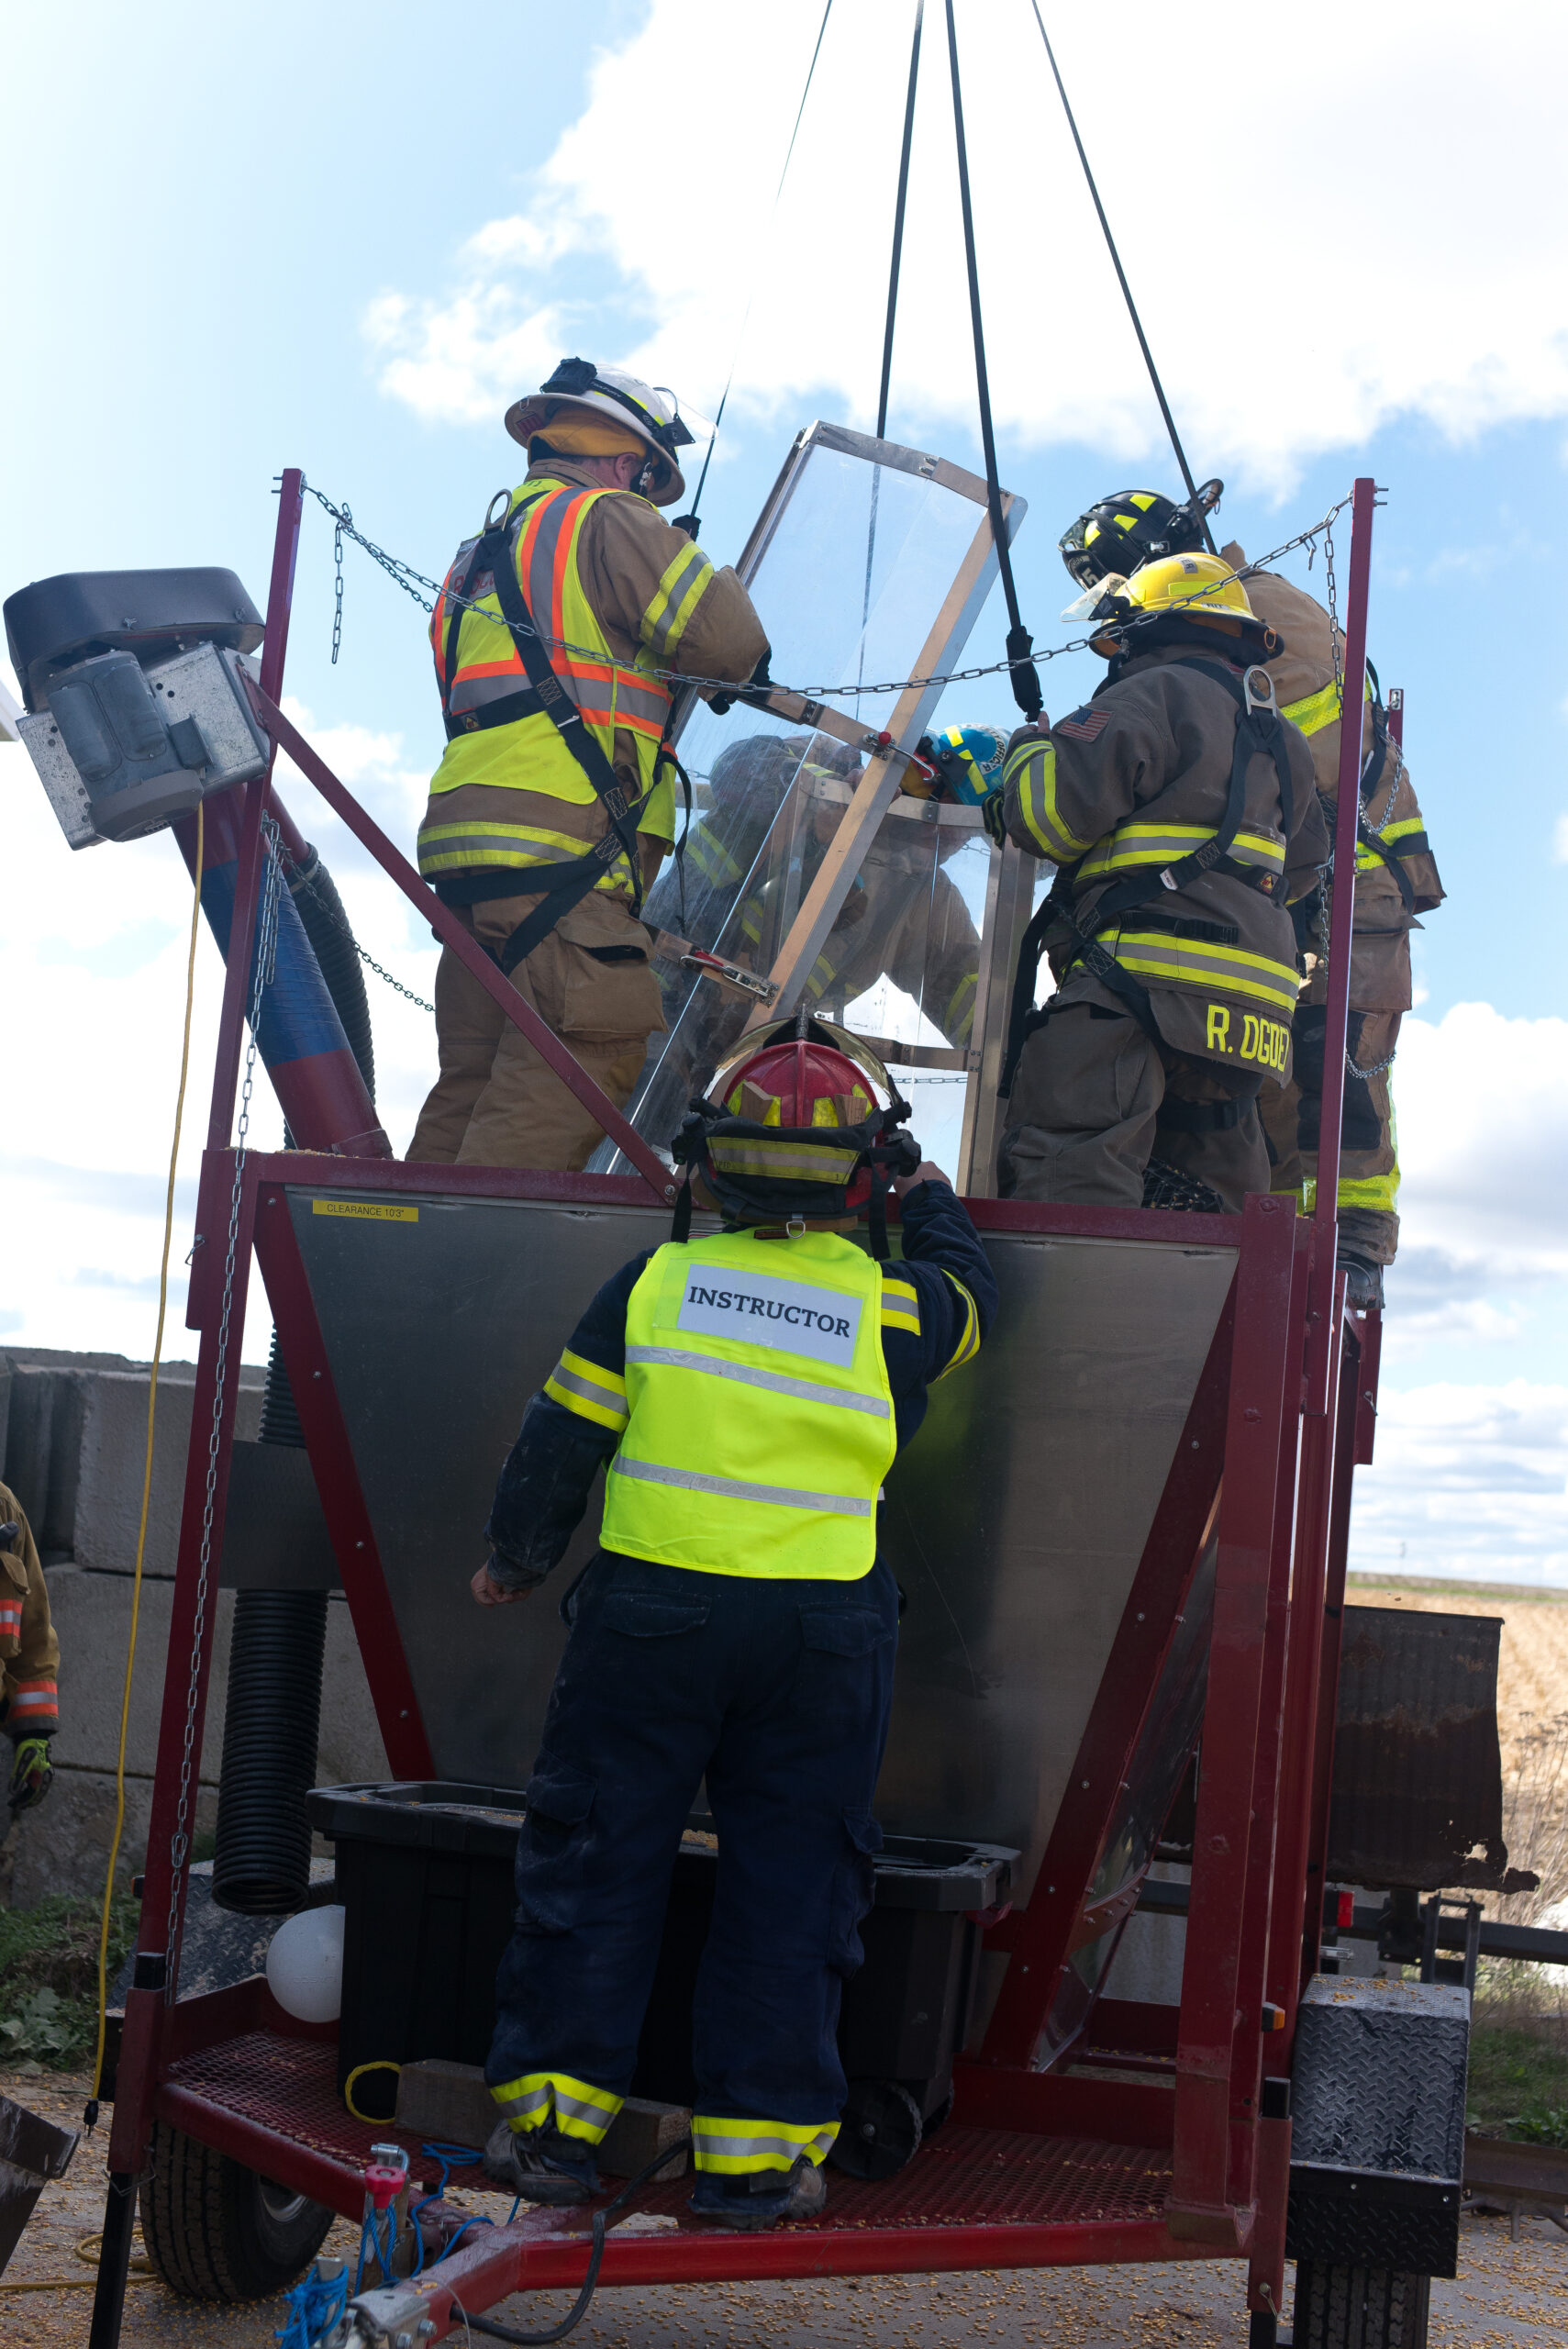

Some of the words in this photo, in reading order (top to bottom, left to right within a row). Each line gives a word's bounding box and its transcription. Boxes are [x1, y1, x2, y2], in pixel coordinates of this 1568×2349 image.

[1207, 1004, 1234, 1053] R.
[327, 1203, 383, 1217] CLEARANCE
[688, 1286, 851, 1338] INSTRUCTOR
